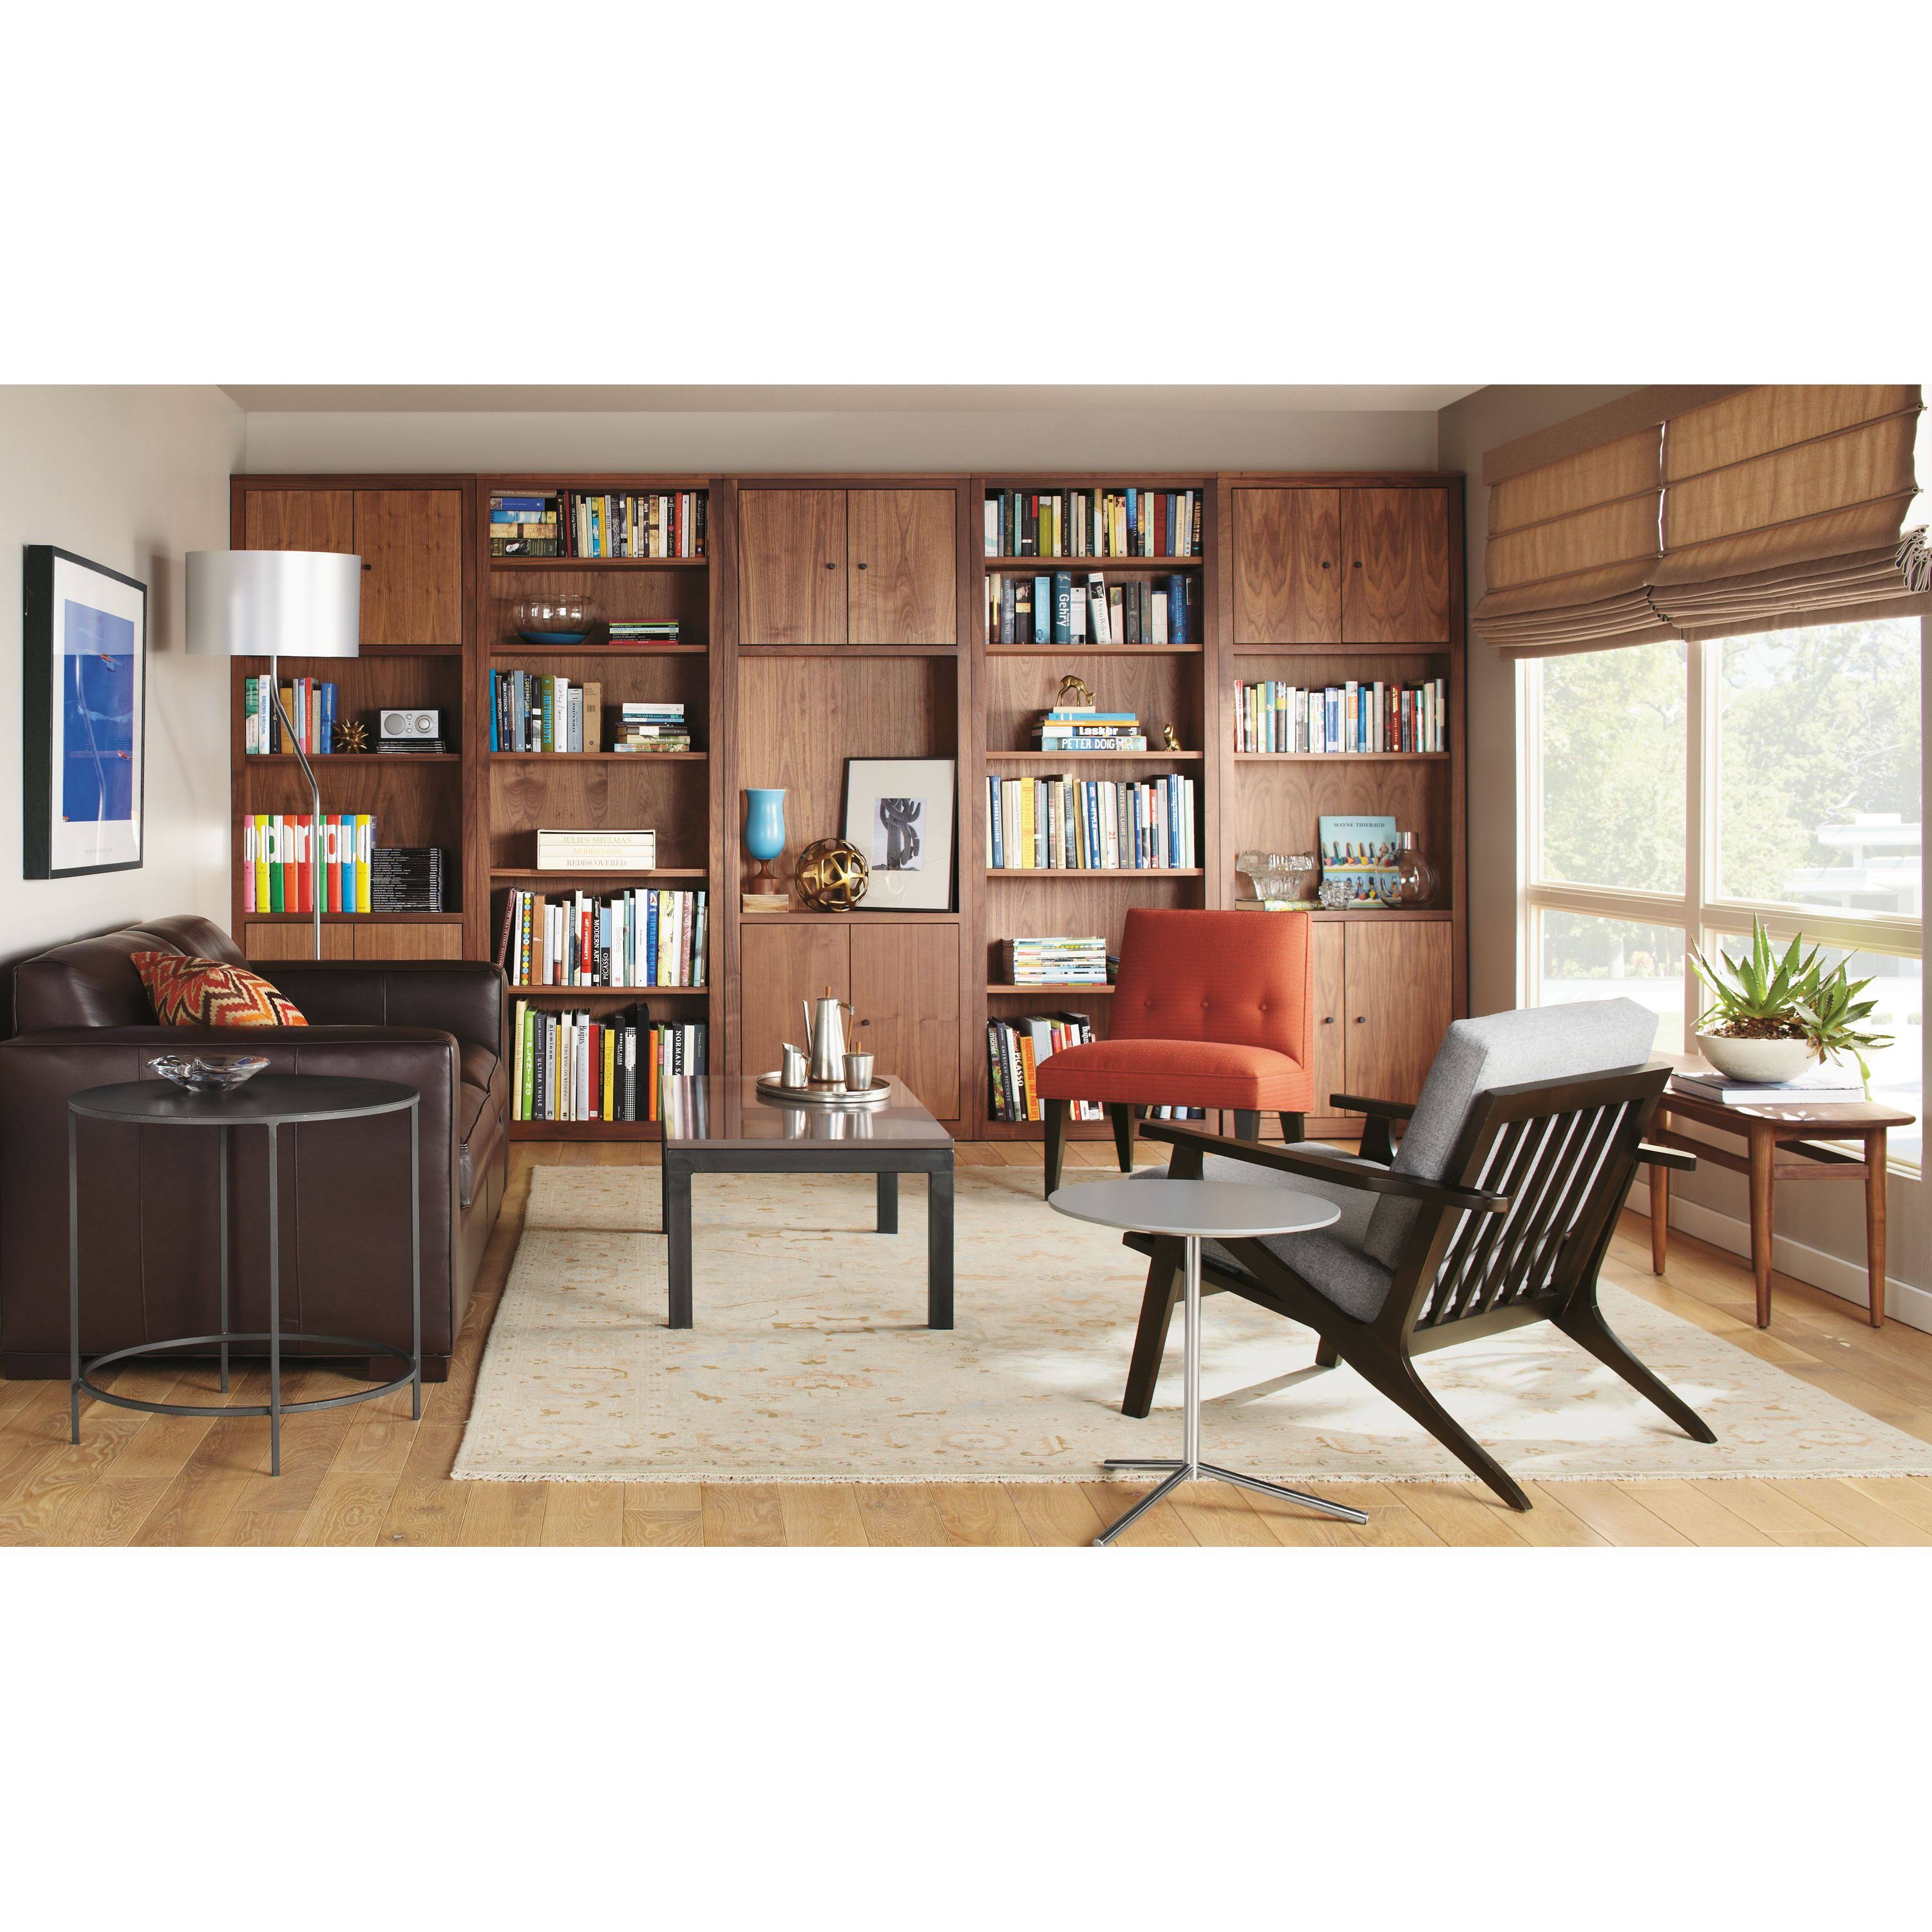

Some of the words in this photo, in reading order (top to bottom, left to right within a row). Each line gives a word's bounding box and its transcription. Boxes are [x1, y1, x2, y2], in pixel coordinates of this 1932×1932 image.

[1056, 594, 1070, 627] Gehry
[543, 696, 551, 743] RETROFONTS
[1079, 726, 1119, 735] Lasker
[1061, 738, 1092, 749] PETER
[1094, 739, 1115, 750] DOIG
[1108, 831, 1115, 840] 21
[578, 1025, 587, 1044] BEATLES
[1015, 1052, 1023, 1086] PICASSO
[1025, 1038, 1035, 1080] RAUSCHENBERG
[604, 1062, 612, 1086] sixties
